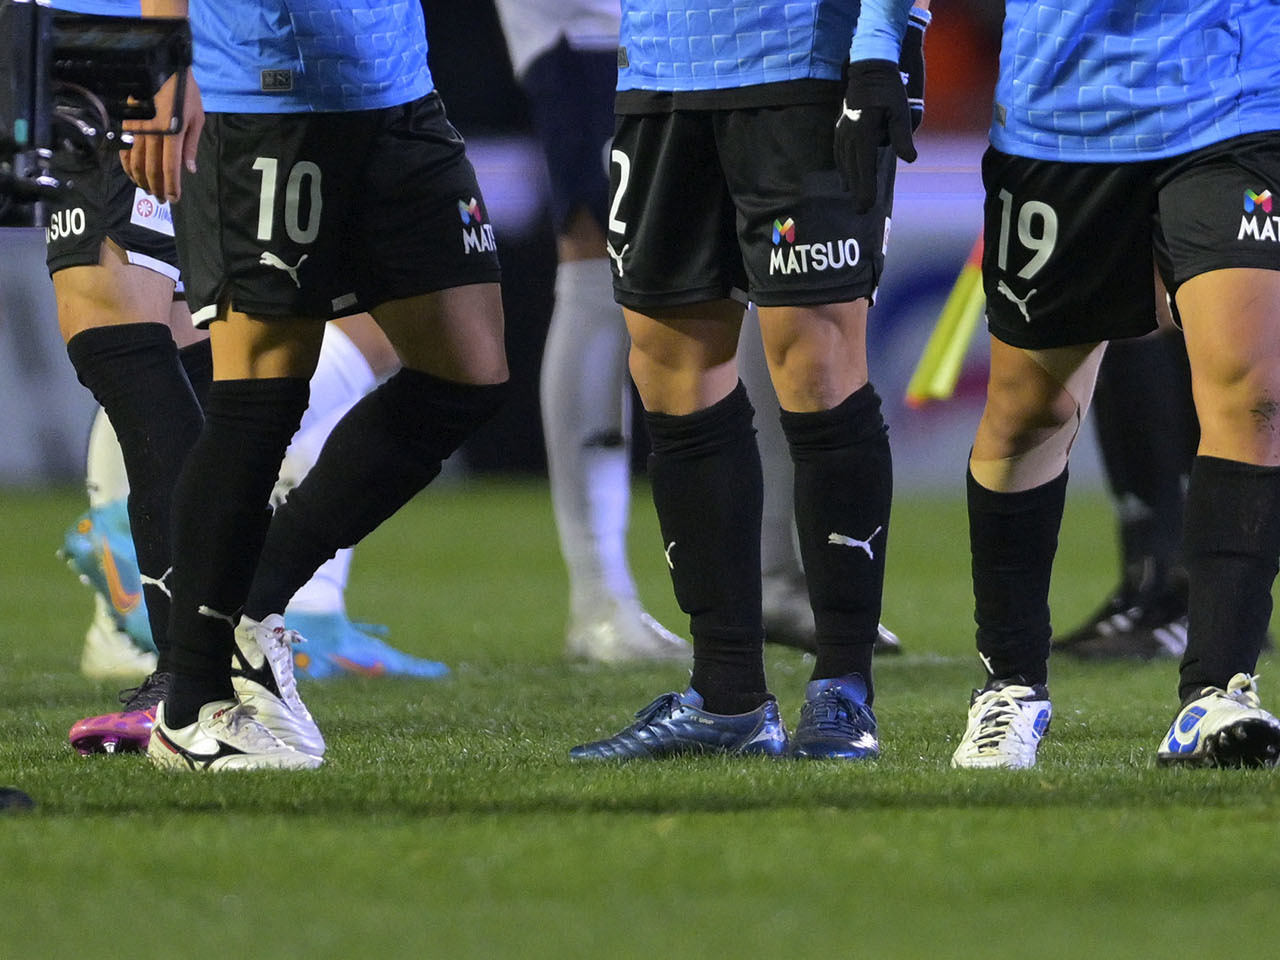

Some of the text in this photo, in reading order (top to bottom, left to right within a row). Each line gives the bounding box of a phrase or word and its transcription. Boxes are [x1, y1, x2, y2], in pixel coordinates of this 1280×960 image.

[252, 158, 323, 244] 10
[609, 150, 631, 235] 2
[998, 188, 1058, 279] 19
[769, 238, 859, 275] MATSUO
